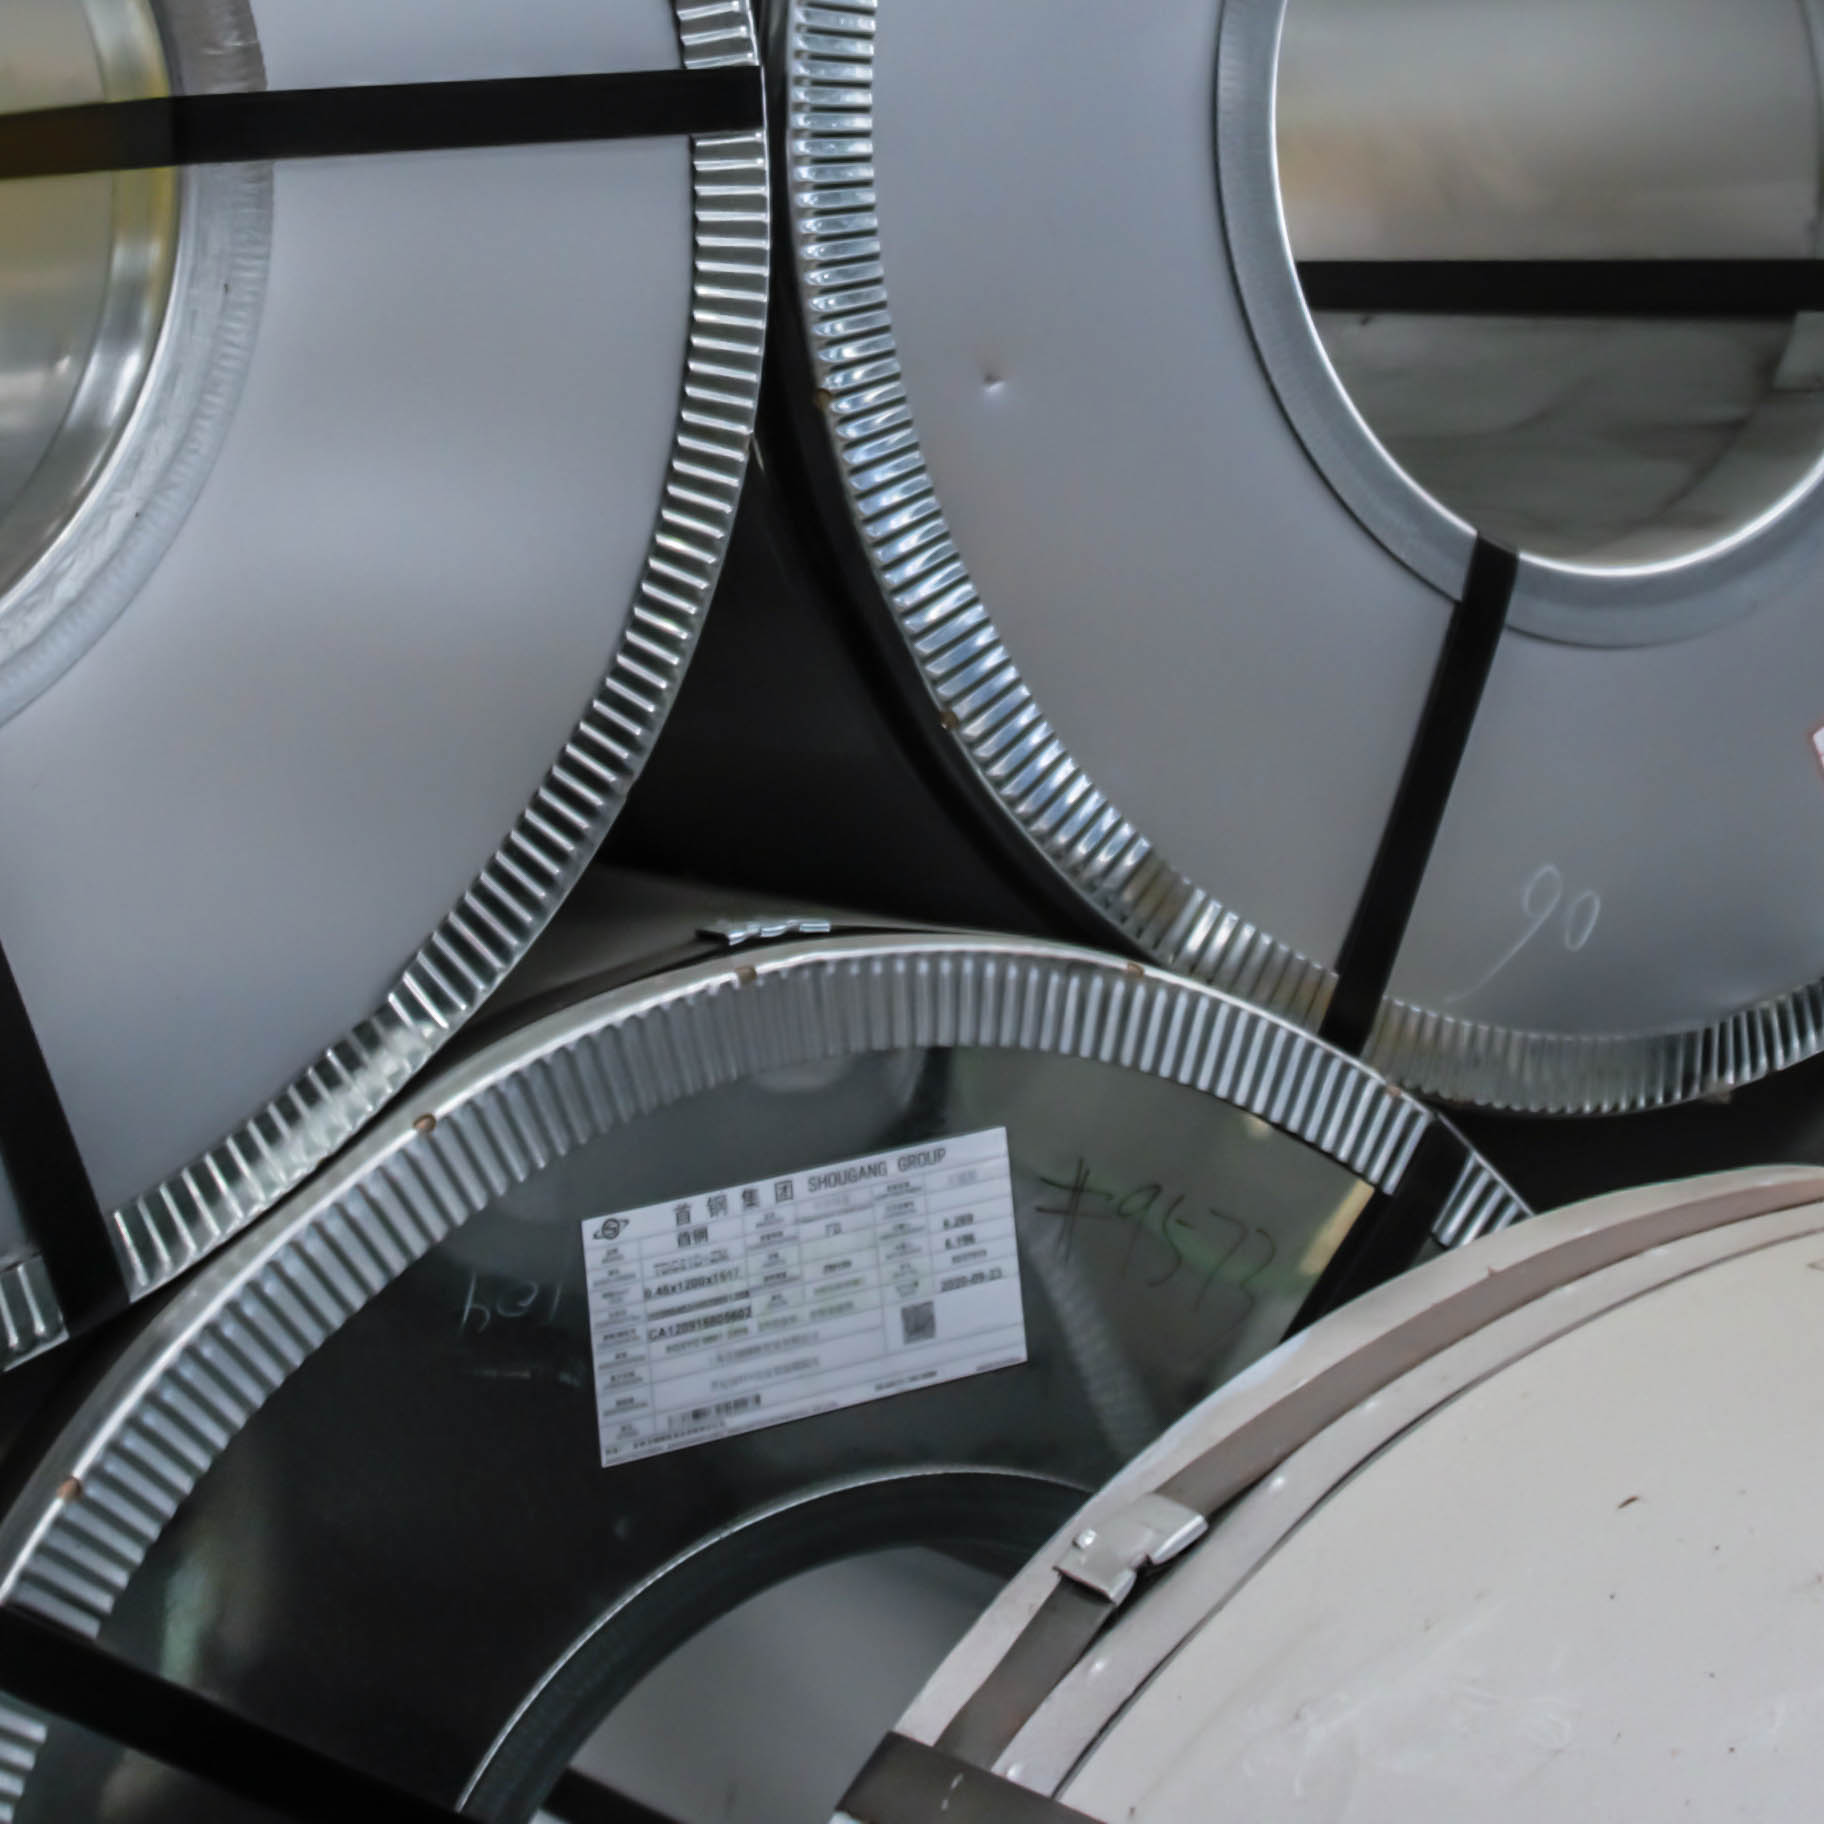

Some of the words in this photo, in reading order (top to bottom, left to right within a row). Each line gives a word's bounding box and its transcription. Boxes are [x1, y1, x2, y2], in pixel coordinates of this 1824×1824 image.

[672, 1178, 794, 1226] 首钢集团
[806, 1159, 888, 1193] SHOUGANG
[896, 1146, 947, 1173] GROUP
